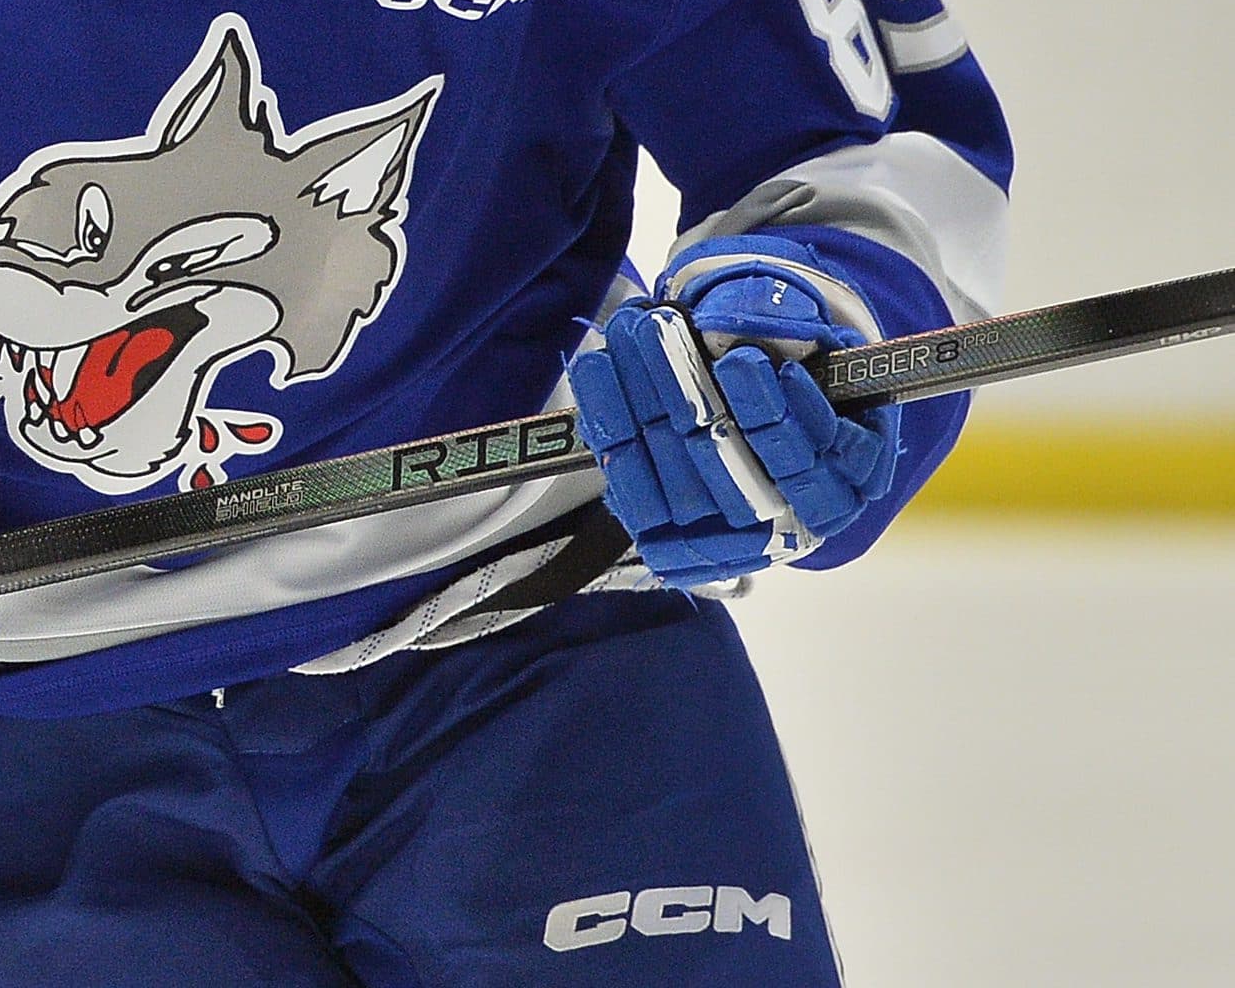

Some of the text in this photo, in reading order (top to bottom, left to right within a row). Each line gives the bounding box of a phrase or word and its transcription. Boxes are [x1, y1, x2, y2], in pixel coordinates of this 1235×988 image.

[391, 414, 585, 491] RIB
[964, 331, 999, 349] PRO
[217, 480, 305, 506] NANOLITE
[543, 885, 791, 952] CCM
